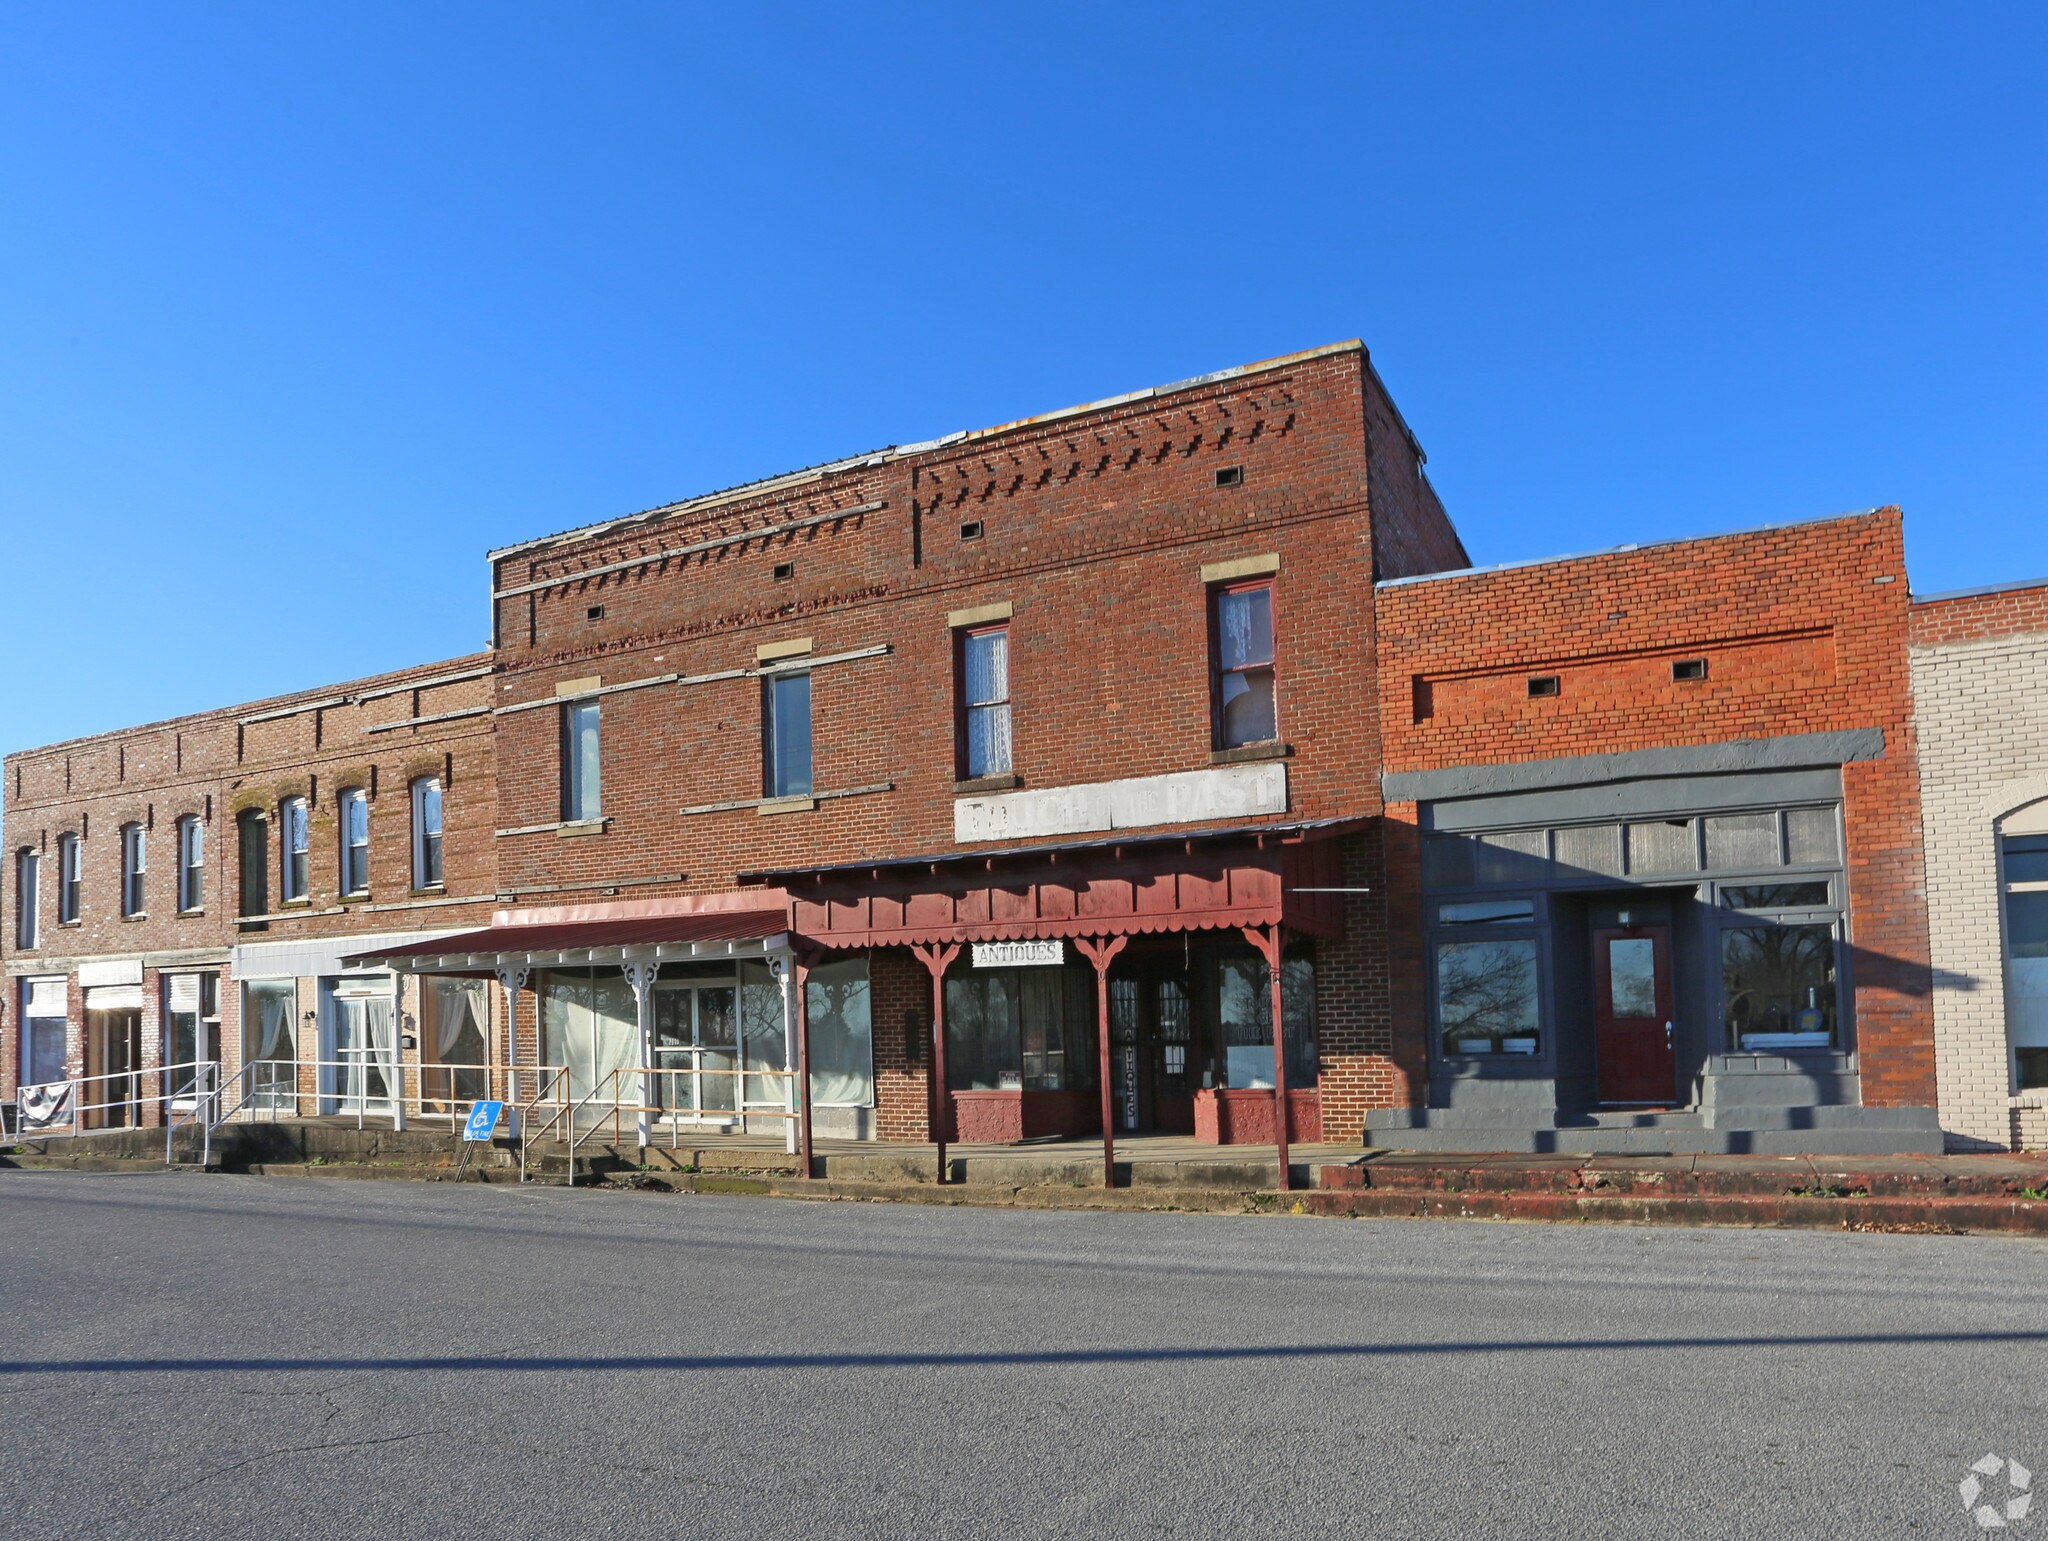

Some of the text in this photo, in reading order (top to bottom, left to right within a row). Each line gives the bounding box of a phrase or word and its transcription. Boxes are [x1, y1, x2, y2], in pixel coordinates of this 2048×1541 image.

[1167, 772, 1277, 816] PAST
[979, 944, 1056, 963] ANTIQUES
[1002, 1077, 1021, 1085] SALE
